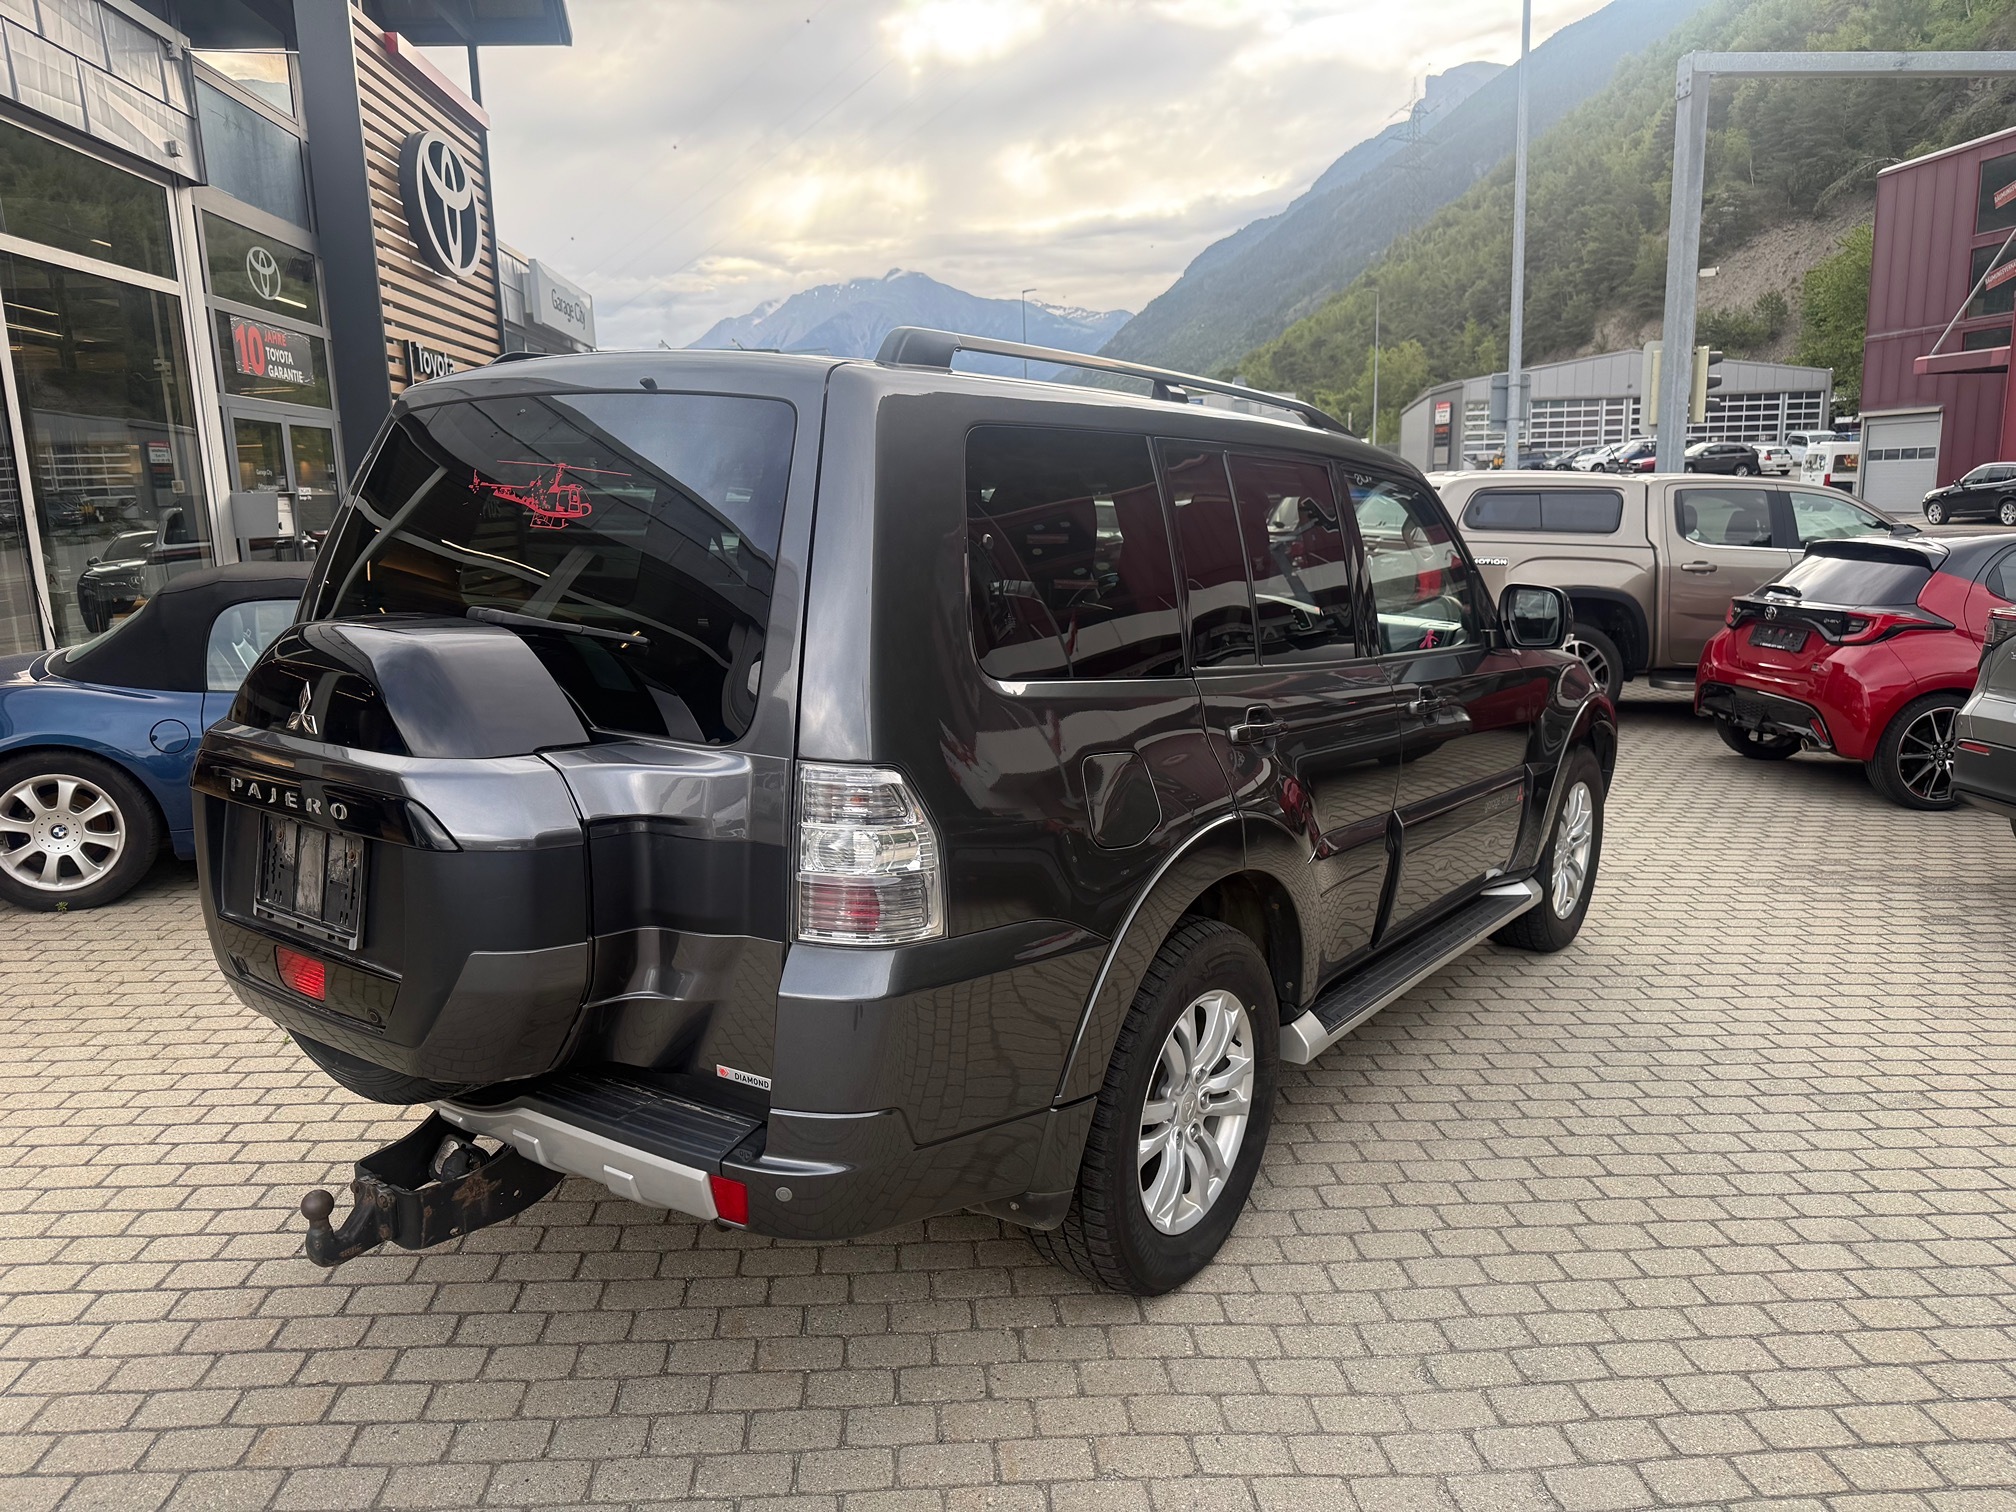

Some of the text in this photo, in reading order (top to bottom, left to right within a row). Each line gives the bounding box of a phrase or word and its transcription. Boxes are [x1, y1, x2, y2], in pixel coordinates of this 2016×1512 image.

[551, 288, 586, 330] Garage City
[235, 323, 265, 376] 10
[264, 329, 287, 347] JAHRE
[265, 346, 294, 366] TOYOTA
[415, 341, 455, 378] Toyota
[268, 364, 304, 384] GARANTIE
[230, 777, 348, 820] PAJERO
[734, 1072, 769, 1088] DIAMOND
